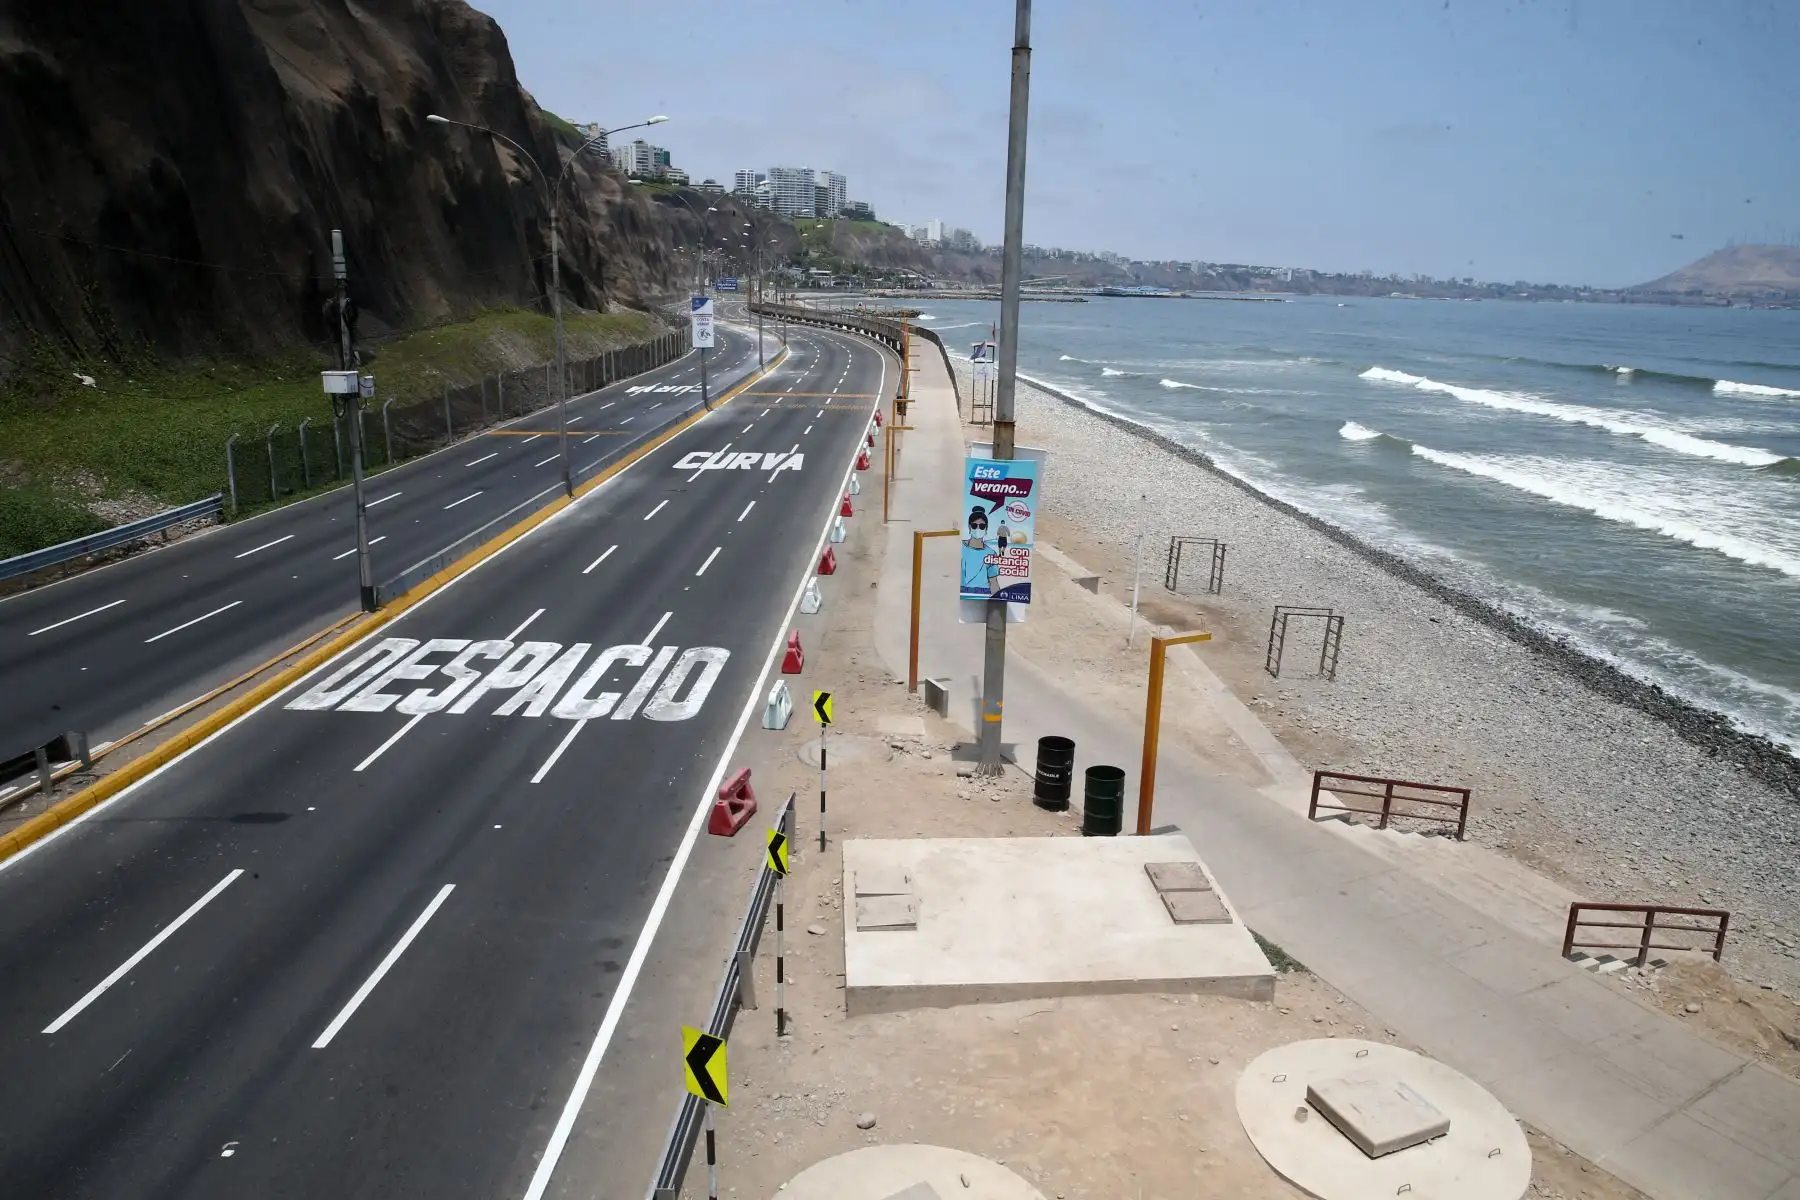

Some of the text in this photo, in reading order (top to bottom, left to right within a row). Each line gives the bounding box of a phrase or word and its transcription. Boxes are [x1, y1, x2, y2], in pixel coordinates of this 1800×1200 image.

[672, 451, 805, 471] CURVA
[974, 466, 1001, 479] Este
[974, 482, 1028, 495] verano...
[1010, 548, 1029, 556] con
[984, 554, 1029, 567] distancia
[999, 567, 1028, 577] social
[282, 637, 731, 722] DESPACIO
